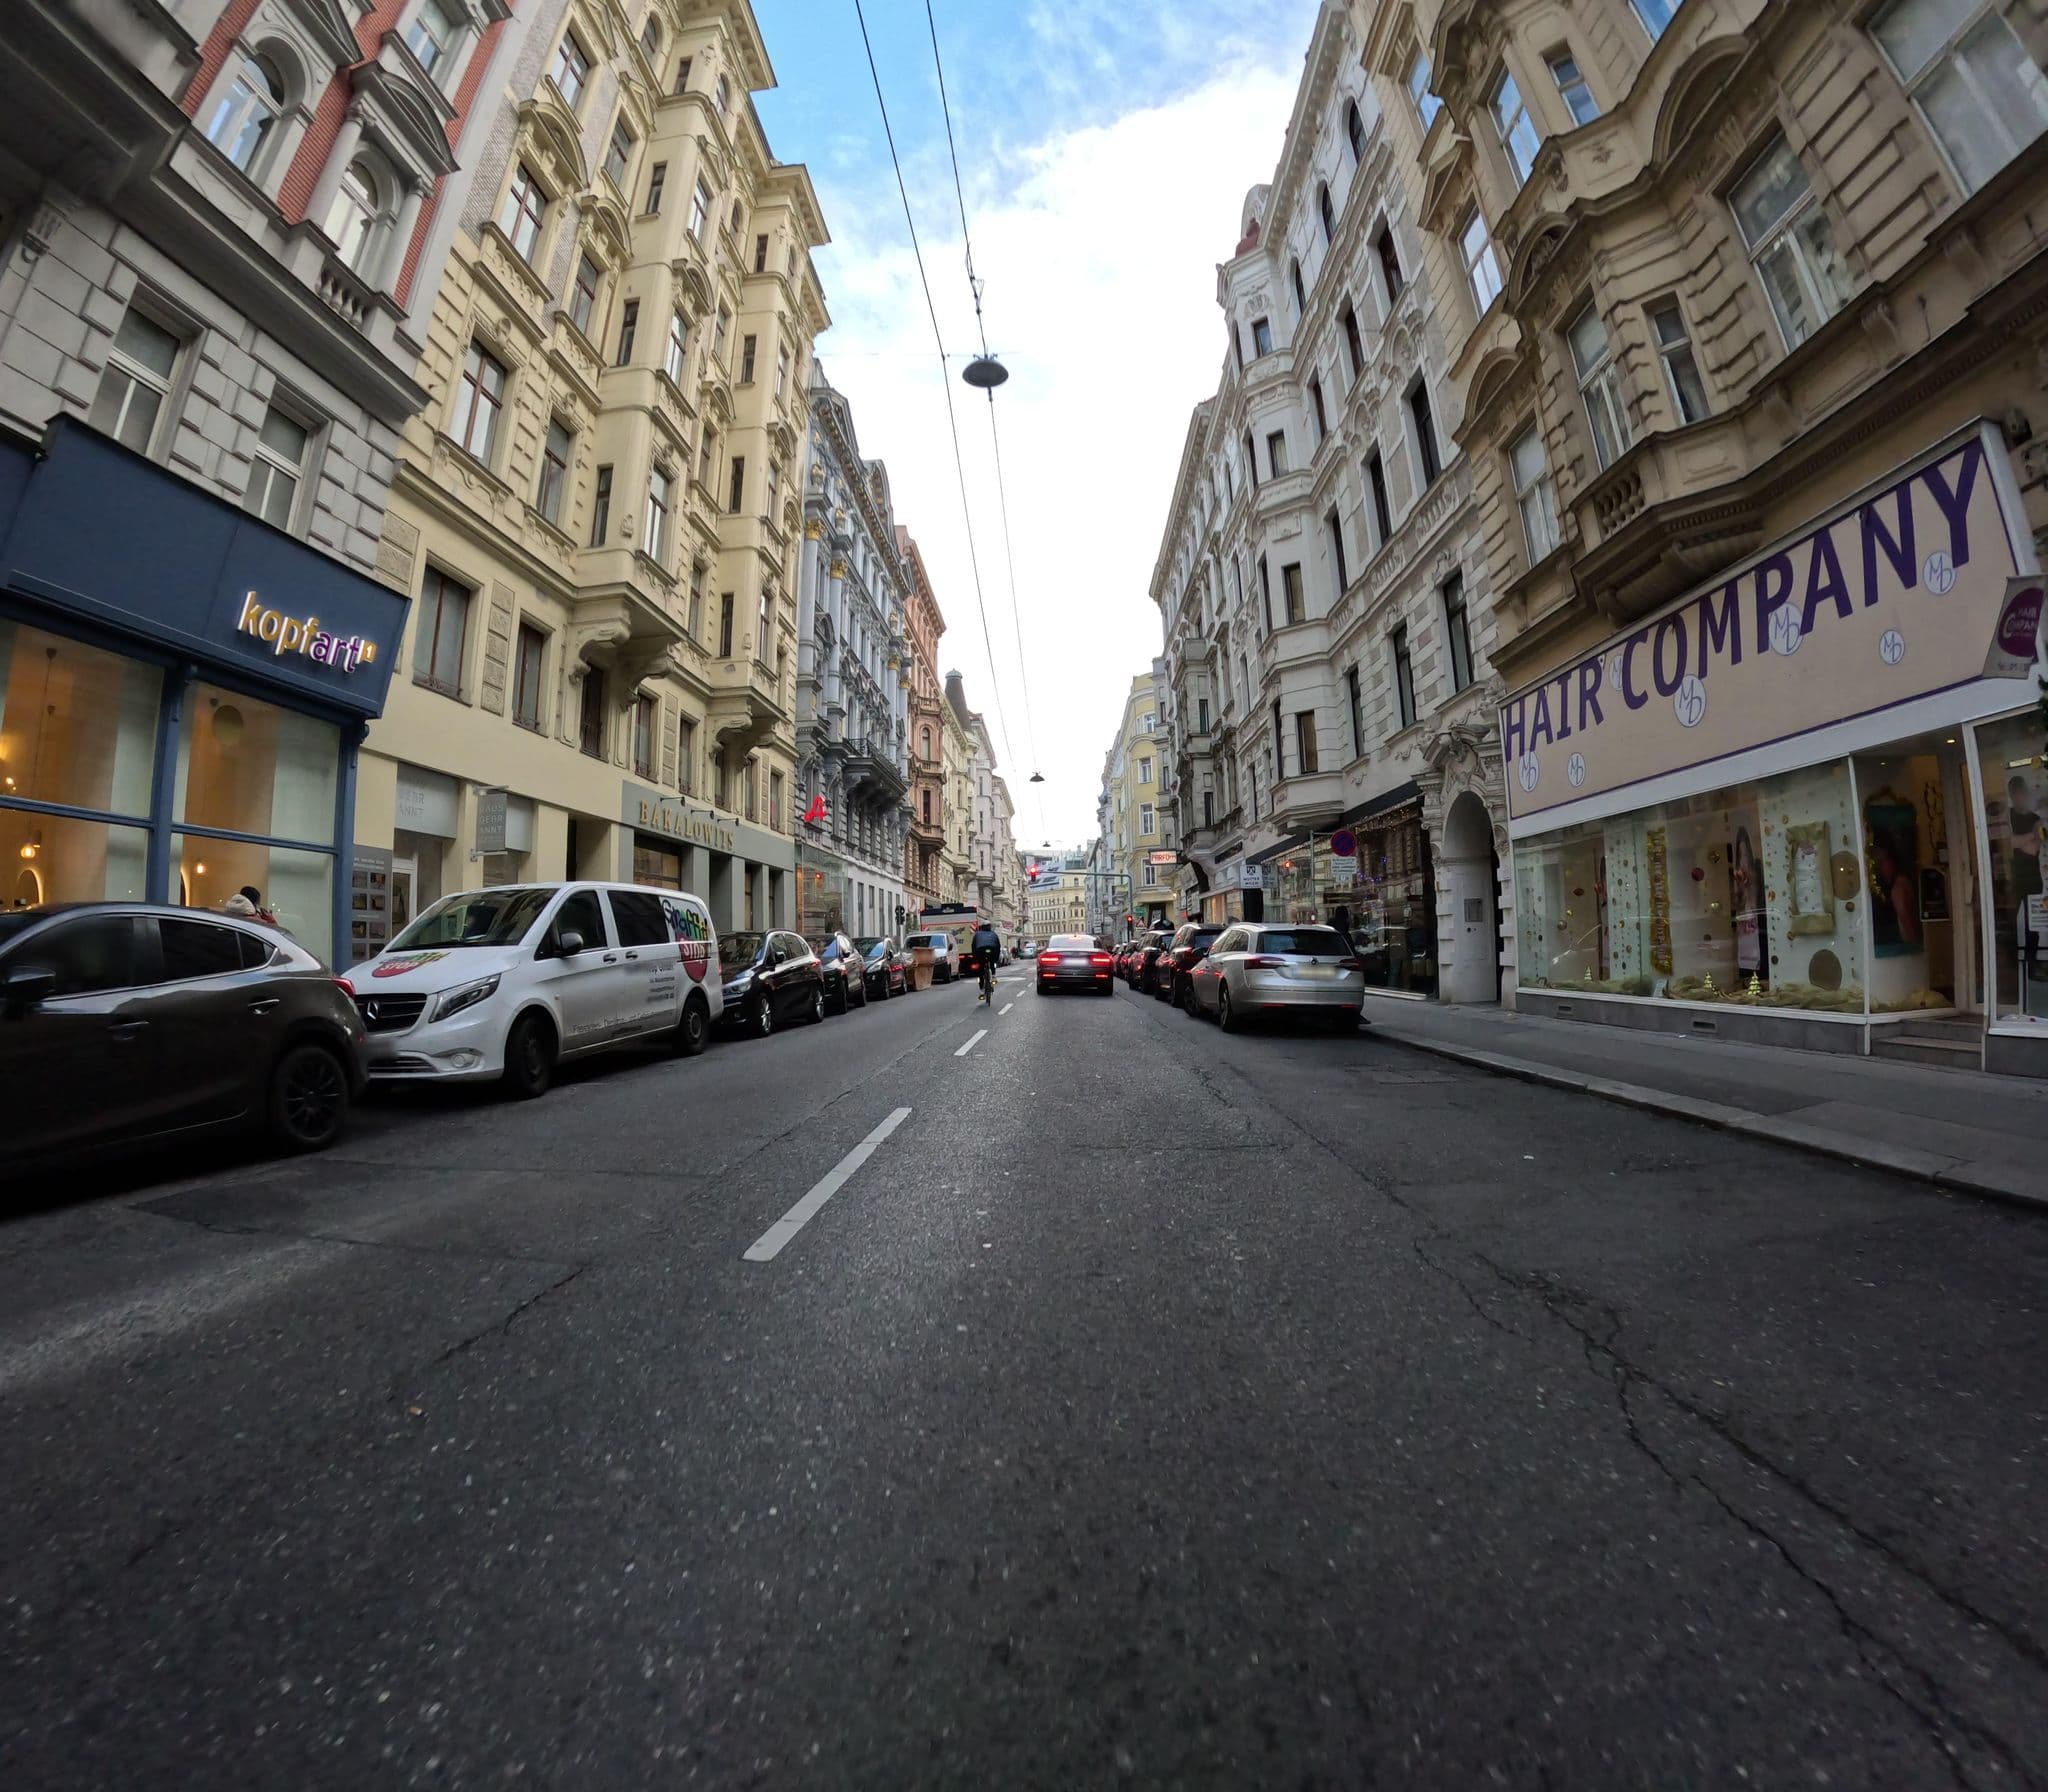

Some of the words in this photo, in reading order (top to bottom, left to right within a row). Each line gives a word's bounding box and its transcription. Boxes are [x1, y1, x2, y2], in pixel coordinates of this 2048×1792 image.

[237, 590, 358, 673] kopfart
[1505, 657, 1604, 762] HAIR
[1621, 436, 1981, 709] COMPANY
[639, 799, 734, 848] BAKALOWITS
